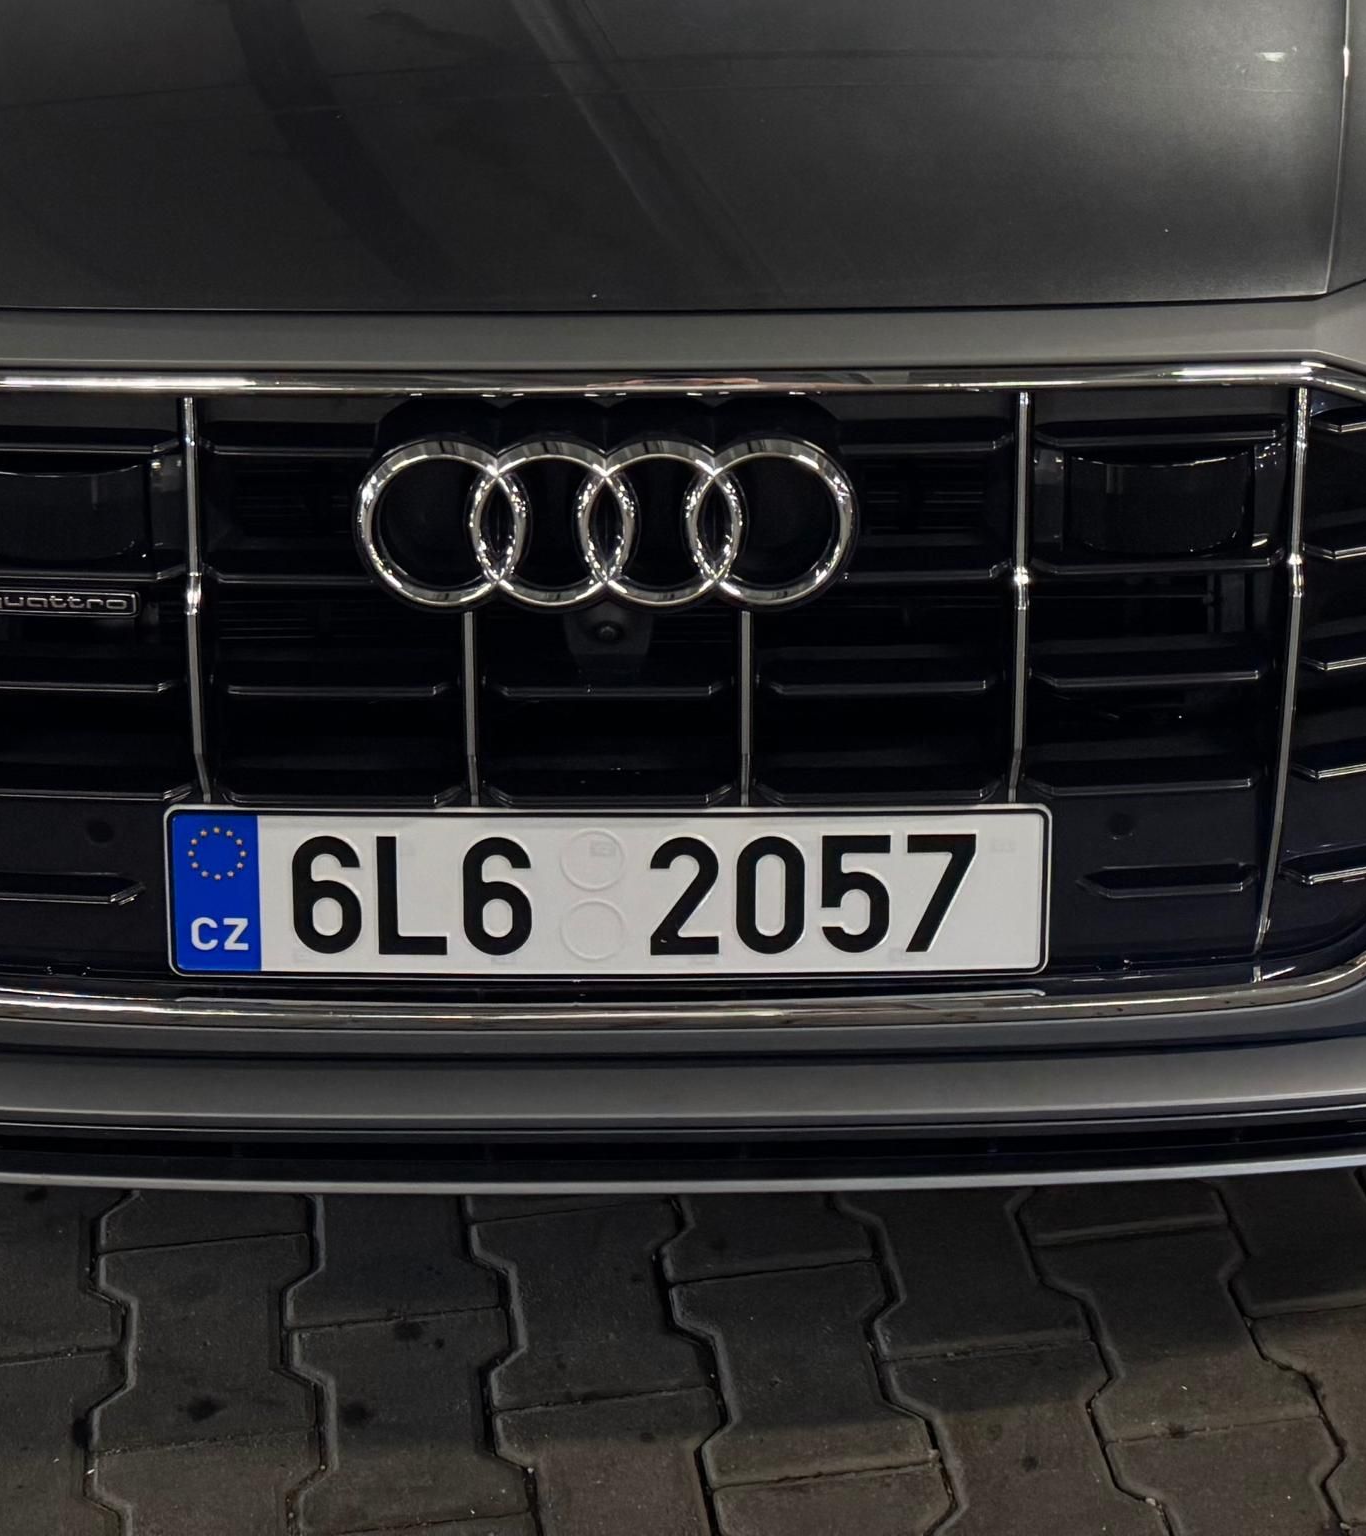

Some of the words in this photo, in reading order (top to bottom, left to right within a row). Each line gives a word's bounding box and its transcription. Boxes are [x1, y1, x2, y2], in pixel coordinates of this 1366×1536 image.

[292, 835, 532, 956] 6L6
[648, 833, 977, 956] 2057
[191, 917, 250, 951] CZ
